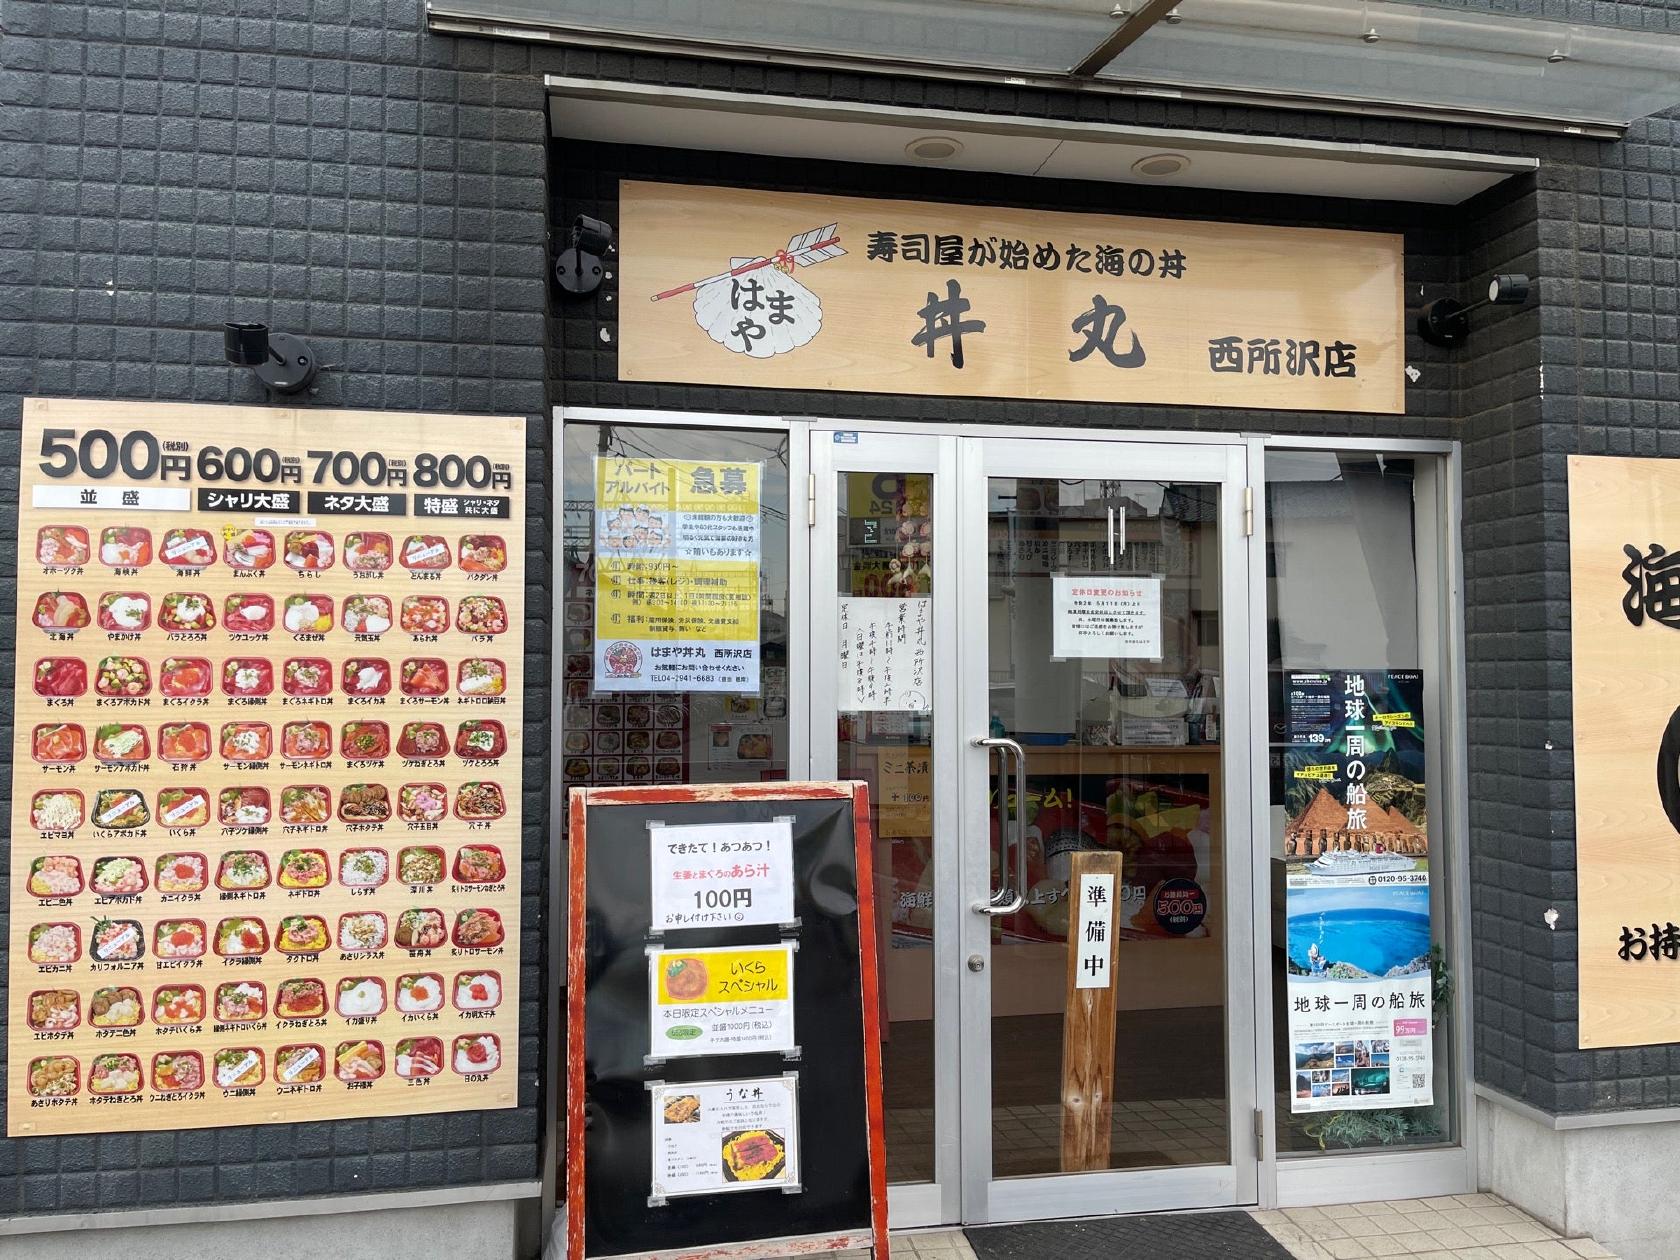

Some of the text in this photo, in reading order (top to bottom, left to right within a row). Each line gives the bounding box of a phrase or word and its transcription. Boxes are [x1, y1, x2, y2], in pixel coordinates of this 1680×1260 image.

[866, 230, 1187, 279] 寿司屋が始めた海の丼
[1208, 336, 1357, 378] 西所沢店
[615, 462, 662, 479] パート
[605, 480, 670, 496] アルバイト
[690, 466, 747, 495] 急募
[81, 489, 139, 506] 並盛
[208, 492, 290, 510] シャリ大盛
[324, 495, 389, 512] ネタ大盛
[424, 498, 458, 514] 特盛
[651, 646, 706, 658] はまや丼丸
[714, 648, 752, 659] 西所沢店
[1344, 674, 1368, 830] 地球一周の船旅
[672, 863, 770, 880] 生姜とまぐろのあら汁
[694, 888, 752, 909] 100円
[1156, 900, 1204, 915] 500円
[665, 913, 732, 924] お申し付け下さい
[1084, 885, 1107, 977] 準備中
[731, 961, 766, 975] いくら
[718, 979, 778, 994] スペシャル
[1294, 990, 1426, 1013] 地球一周の船旅
[663, 1007, 774, 1018] 本日限定スペシャルメニュー
[726, 1087, 764, 1101] うな丼
